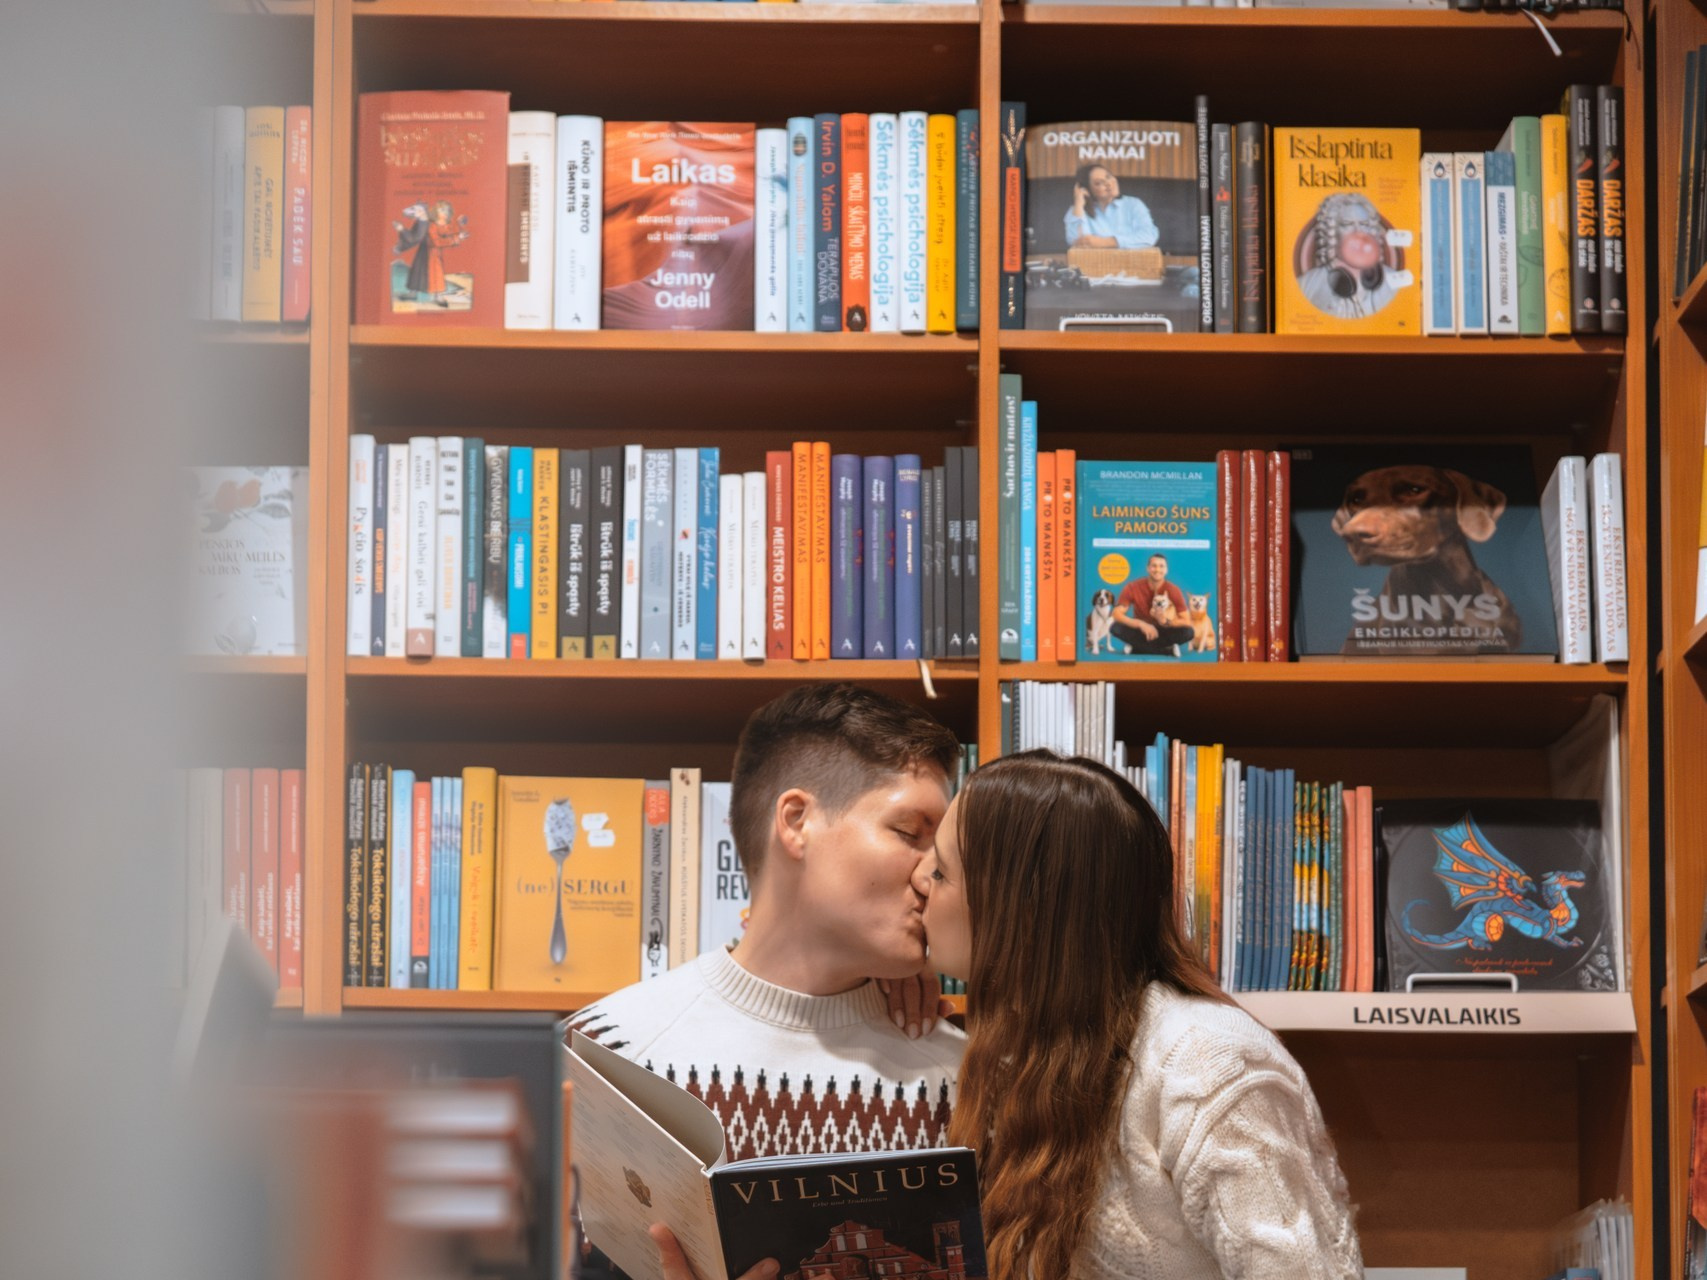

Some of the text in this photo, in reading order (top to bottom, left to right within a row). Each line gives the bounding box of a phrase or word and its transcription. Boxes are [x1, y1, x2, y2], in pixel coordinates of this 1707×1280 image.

[1043, 131, 1180, 146] ORGANIZUOTI
[1078, 146, 1145, 160] NAMAI
[566, 160, 578, 214] IŠMINTIS
[580, 140, 595, 234] KŪNO IR PROTO
[631, 157, 736, 184] Laikas
[821, 120, 836, 232] Irvin D. Yalom
[848, 172, 865, 202] MINČIŲ
[1298, 163, 1367, 188] klasika
[873, 121, 893, 305] Sėkmės psichologija
[904, 118, 924, 303] Sėkmės psichologija
[1497, 192, 1507, 235] MEZGIMAS
[1577, 179, 1598, 236] DARŽAS
[1603, 179, 1624, 236] DARŽAS
[292, 238, 304, 267] SAU
[520, 211, 529, 264] SMEGENYS
[650, 268, 715, 290] Jenny
[817, 251, 829, 303] DOVANA
[828, 237, 839, 300] TERAPIJOS
[848, 252, 864, 280] MENAS
[1200, 216, 1212, 324] ORGANIZUOTI NAMAI
[654, 290, 711, 309] Odell
[1005, 396, 1016, 438] matas!
[1004, 440, 1014, 455] ir
[490, 457, 503, 518] GYVENIMAS
[644, 453, 658, 521] FORMULĖS
[655, 453, 670, 502] SĖKMĖS
[1003, 460, 1015, 499] Šachas
[1022, 481, 1033, 510] BANGA
[1100, 470, 1203, 480] BRANDON MCMILLAN
[490, 520, 501, 536] BE
[797, 453, 807, 563] MANIFESTAVIMAS
[816, 453, 826, 563] MANIFESTAVIMAS
[1092, 502, 1210, 519] LAIMINGO ŠUNS
[1115, 521, 1188, 534] PAMOKOS
[538, 496, 550, 615] KLASTINGASIS PI
[599, 521, 614, 558] Ištrūk
[773, 527, 784, 582] MEISTRO
[1043, 522, 1054, 580] MANKŠTA
[1063, 519, 1074, 577] MANKŠTA
[566, 524, 583, 617] Ištrūk iš spąstų
[600, 560, 613, 571] iš
[1576, 530, 1587, 632] EKSTREMALAUS
[1612, 527, 1625, 629] EKSTREMALAUS
[596, 573, 612, 615] spąstų
[772, 586, 784, 630] KELIAS
[1351, 588, 1502, 623] ŠUNYS
[1354, 627, 1505, 639] ENCIKLOPEDIJA
[1568, 594, 1578, 655] VADOVAS
[1604, 592, 1616, 653] VADOVAS
[563, 878, 635, 895] SERGU
[650, 828, 665, 917] ŽARNYNO ŽAVUMYNAI
[348, 847, 363, 965] Toksikologo užrašai
[370, 847, 384, 966] Toksikologo užrašai
[1353, 1006, 1521, 1026] LAISVALAIKIS
[730, 1162, 960, 1205] VILNIUS
